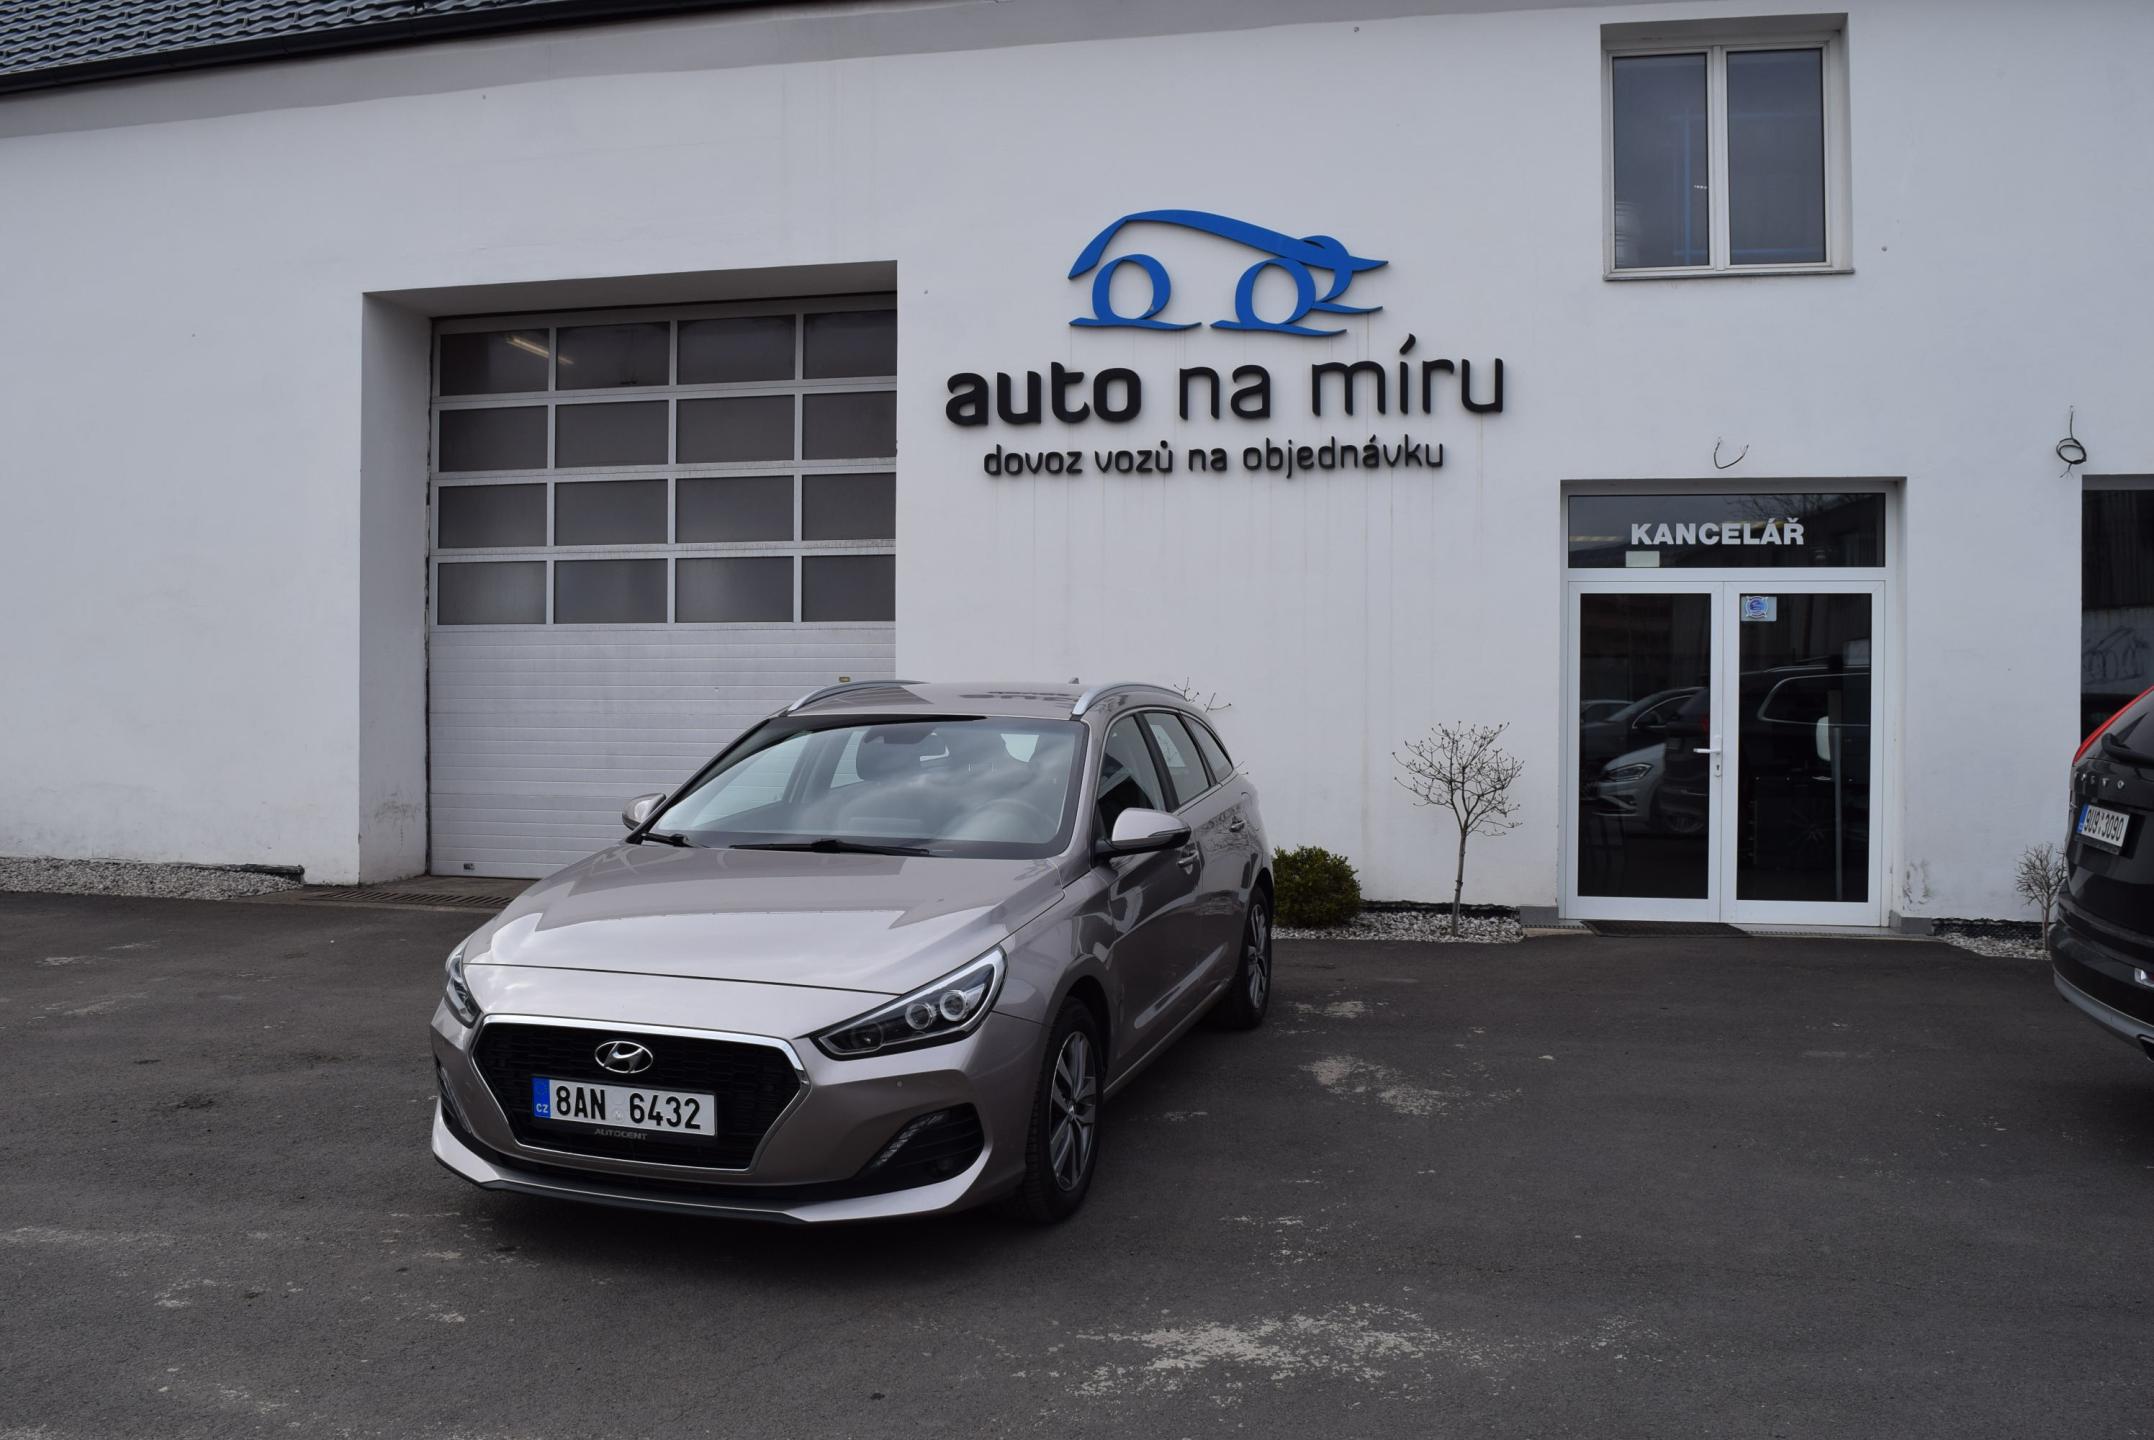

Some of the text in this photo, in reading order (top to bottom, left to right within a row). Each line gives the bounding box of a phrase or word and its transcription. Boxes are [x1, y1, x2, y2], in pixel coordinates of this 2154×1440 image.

[945, 333, 1504, 428] auto na míru
[983, 433, 1444, 480] dovoz vozů na objednávku
[1631, 517, 1805, 545] KANCELÁŘ
[535, 1102, 549, 1114] CZ
[555, 1085, 701, 1130] 8AN 6432
